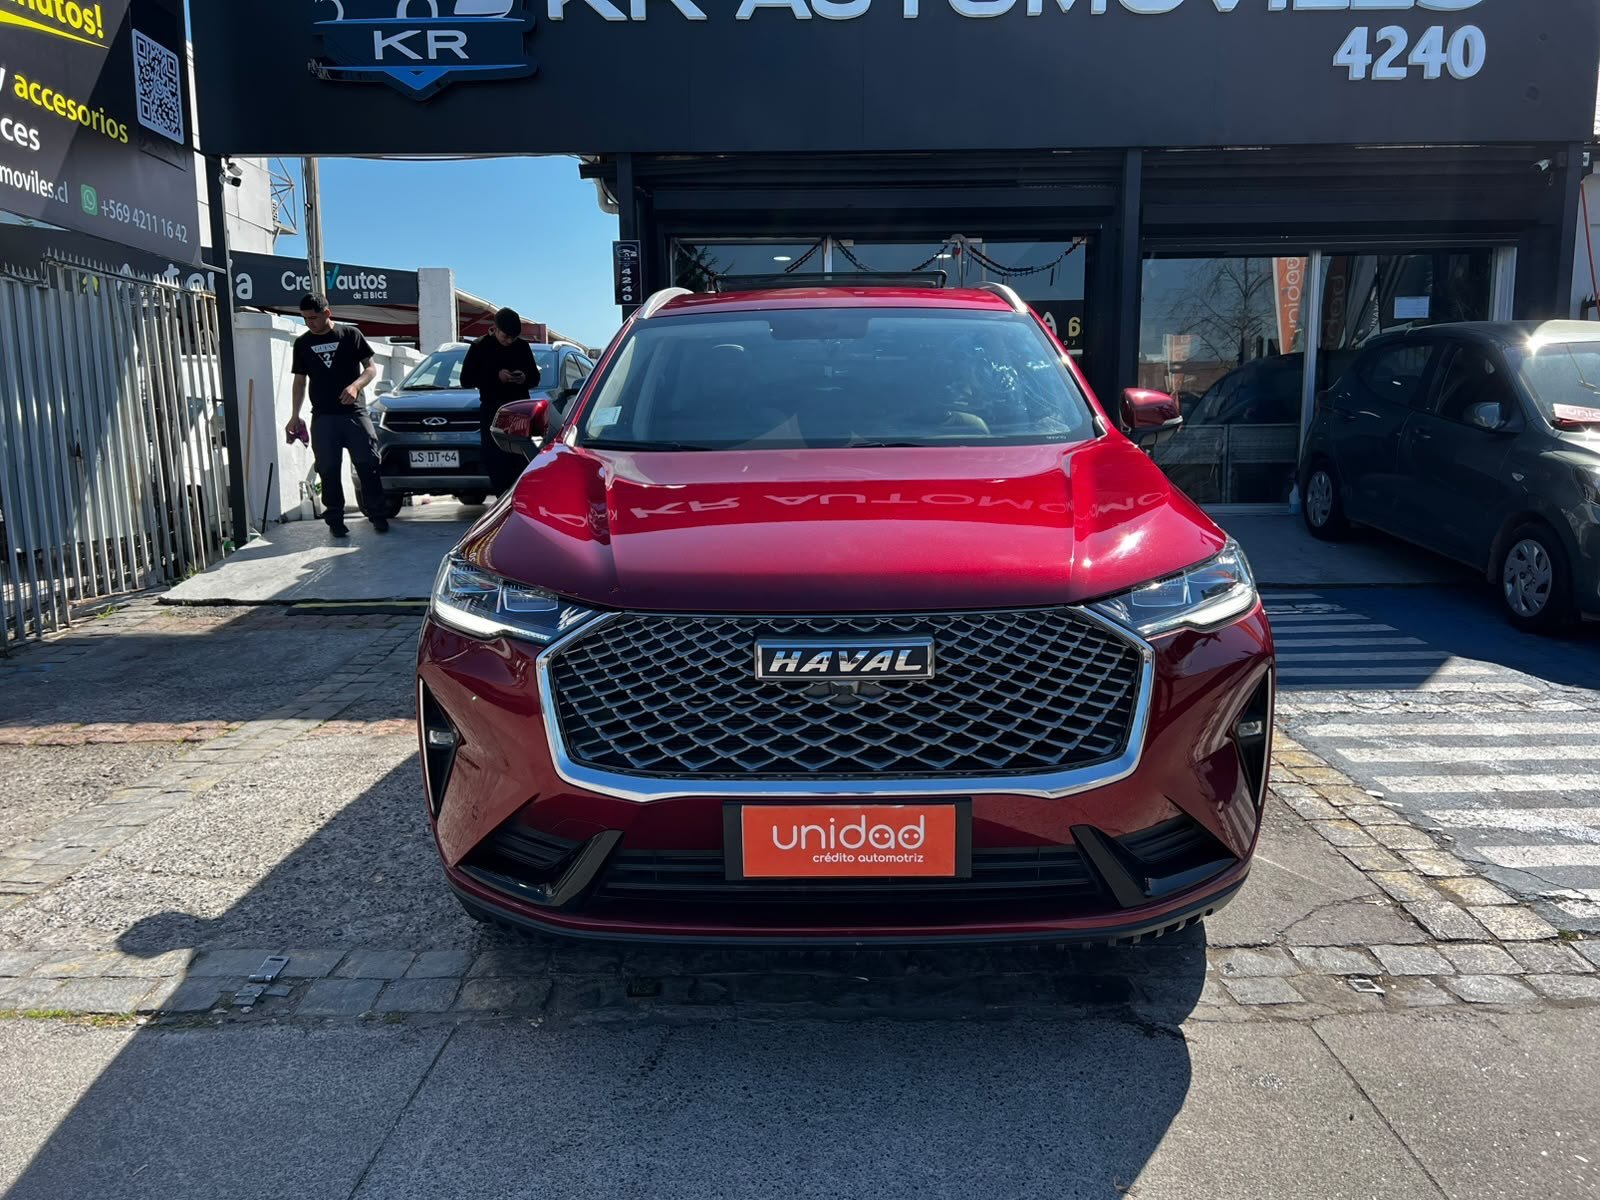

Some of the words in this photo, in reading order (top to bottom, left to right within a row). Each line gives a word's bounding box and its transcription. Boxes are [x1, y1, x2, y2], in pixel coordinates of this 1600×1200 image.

[373, 30, 469, 60] KR
[1332, 25, 1486, 81] 4240
[14, 74, 129, 144] accesorios
[101, 200, 130, 224] +569
[133, 207, 158, 233] 4211
[161, 218, 174, 239] 16
[175, 224, 188, 243] 42
[370, 291, 388, 299] BICE
[621, 268, 633, 301] 4240
[769, 651, 922, 673] HAVAL
[772, 814, 925, 850] unidad
[813, 852, 855, 863] crédito
[858, 853, 924, 863] automotriz
